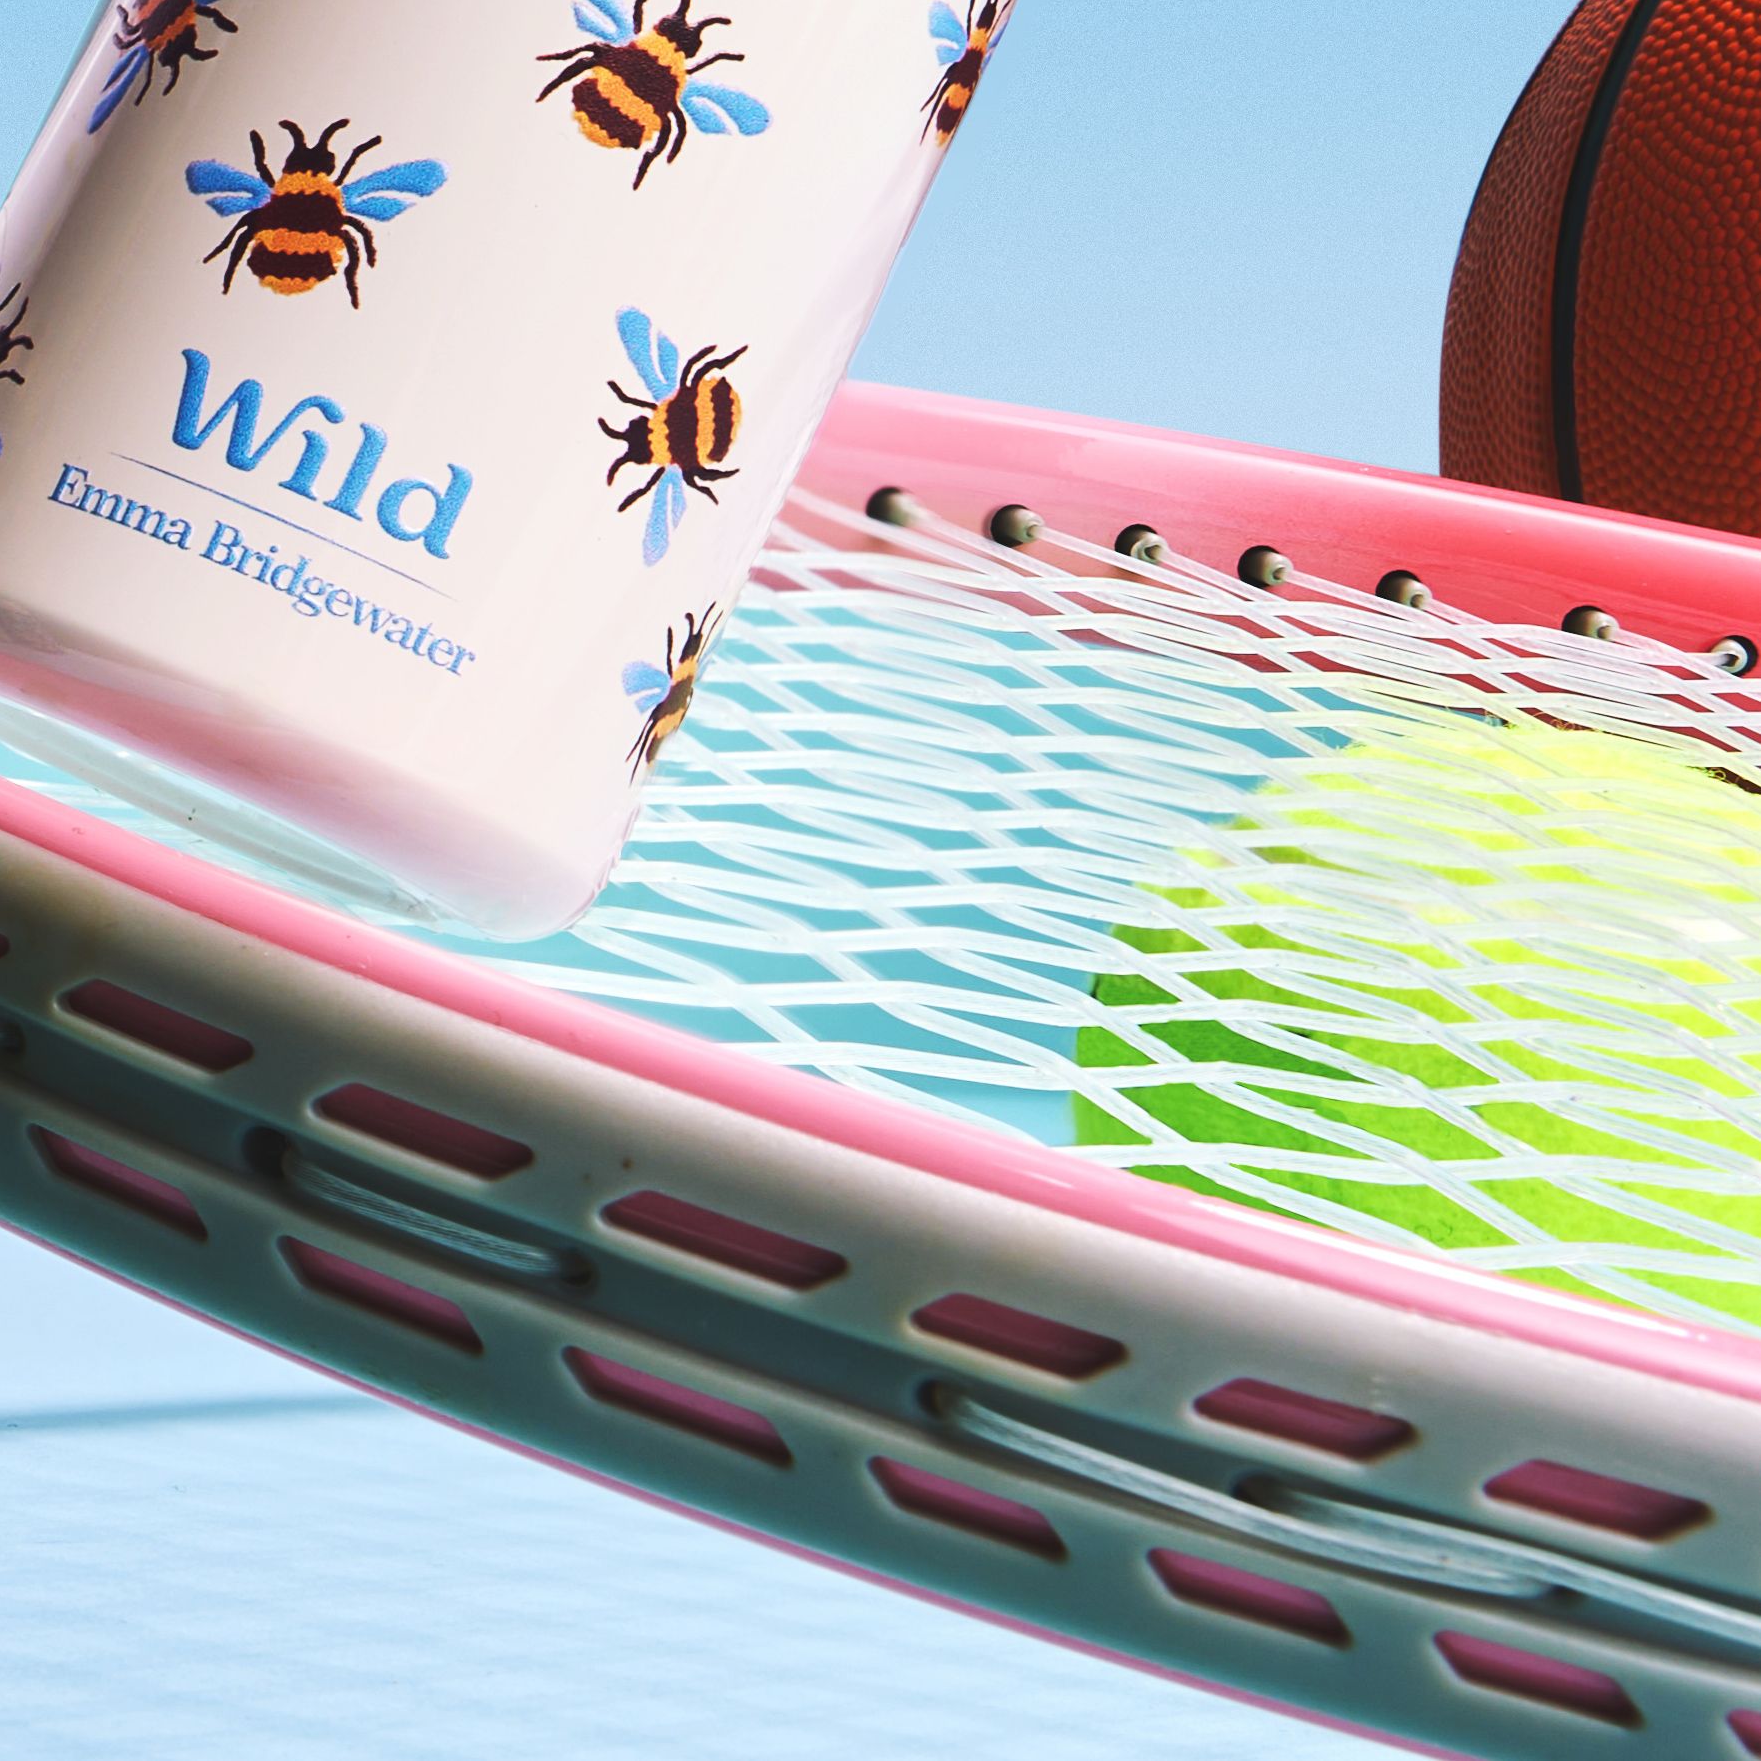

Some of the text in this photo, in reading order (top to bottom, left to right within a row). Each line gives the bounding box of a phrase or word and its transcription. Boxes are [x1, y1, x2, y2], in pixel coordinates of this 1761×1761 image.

[171, 348, 474, 560] Wild
[46, 463, 477, 677] Emma Bridgewater
